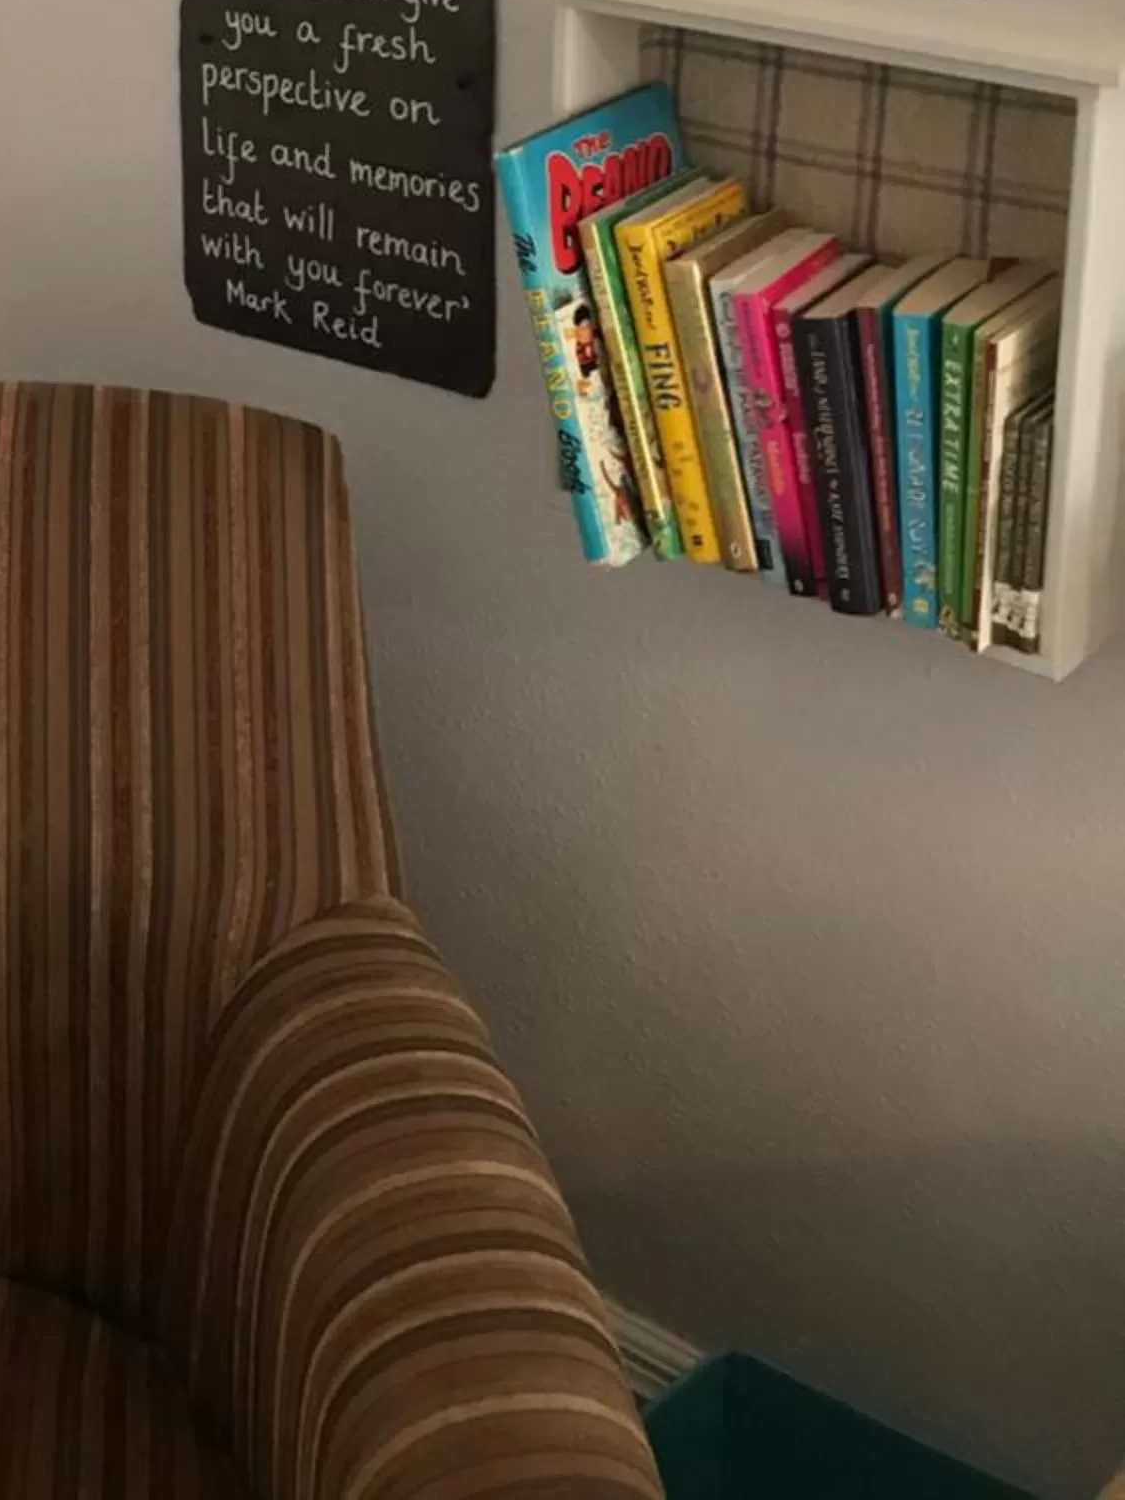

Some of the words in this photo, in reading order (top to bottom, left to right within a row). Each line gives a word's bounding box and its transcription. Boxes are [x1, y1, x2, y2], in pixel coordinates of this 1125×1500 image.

[222, 10, 277, 50] you
[296, 21, 321, 43] a
[333, 23, 437, 74] fresh
[202, 62, 371, 117] perspective
[389, 97, 441, 126] on
[202, 116, 257, 185] life
[271, 143, 337, 180] and
[349, 157, 480, 213] memories
[201, 232, 265, 270] with
[284, 255, 343, 292] you
[202, 177, 269, 225] that
[283, 202, 334, 242] will
[356, 225, 466, 277] remain
[225, 279, 293, 324] Mark
[312, 300, 383, 349] Reid
[642, 340, 683, 413] FING
[941, 359, 964, 432] EXTRA
[941, 438, 960, 494] TIME
